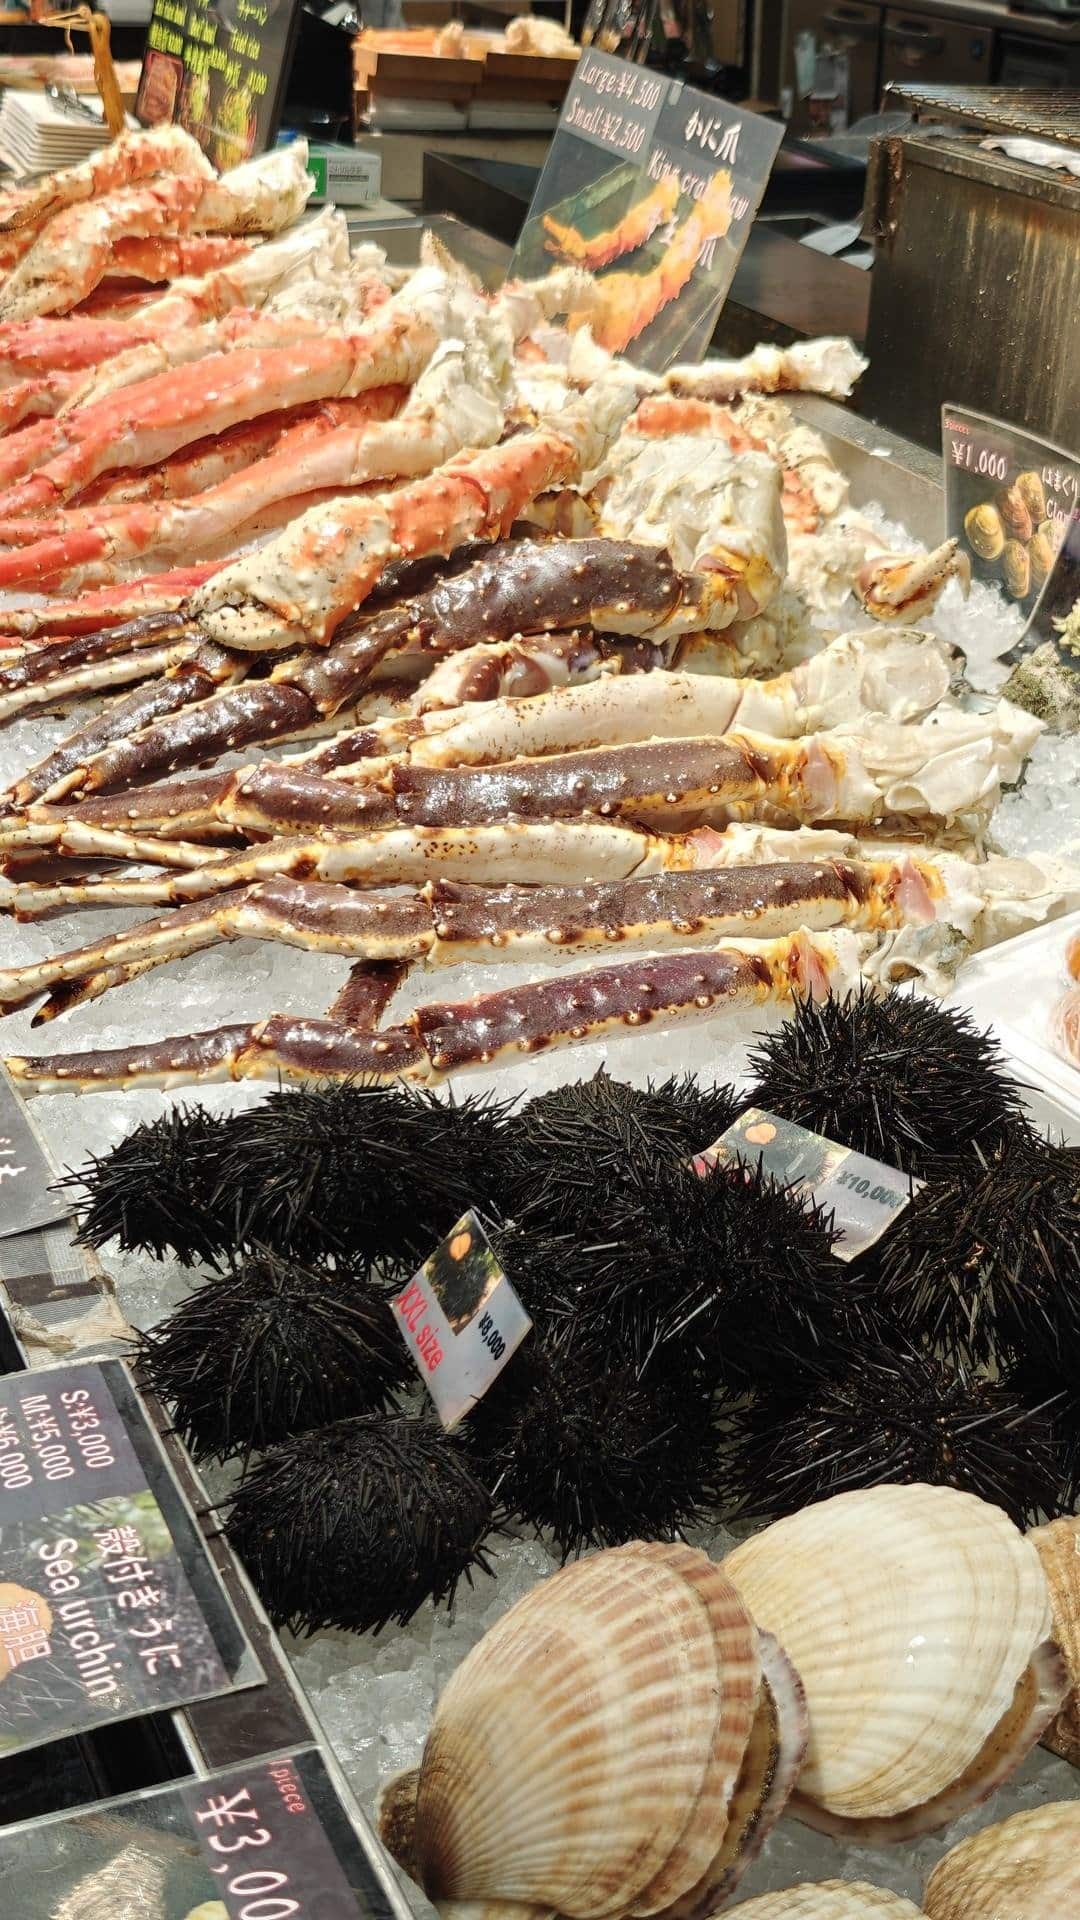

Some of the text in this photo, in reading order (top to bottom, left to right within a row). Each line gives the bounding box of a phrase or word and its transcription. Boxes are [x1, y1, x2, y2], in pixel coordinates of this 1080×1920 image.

[685, 110, 742, 165] かに爪
[951, 440, 1006, 481] ¥1,000
[394, 1281, 444, 1371] XXL size
[478, 1310, 507, 1361] ¥8,000
[20, 1394, 76, 1480] M:¥5,000
[60, 1389, 115, 1468] S:¥3,000
[39, 1537, 123, 1698] Sea urchin
[93, 1525, 183, 1676] 殻付きうに
[267, 1768, 306, 1815] piece
